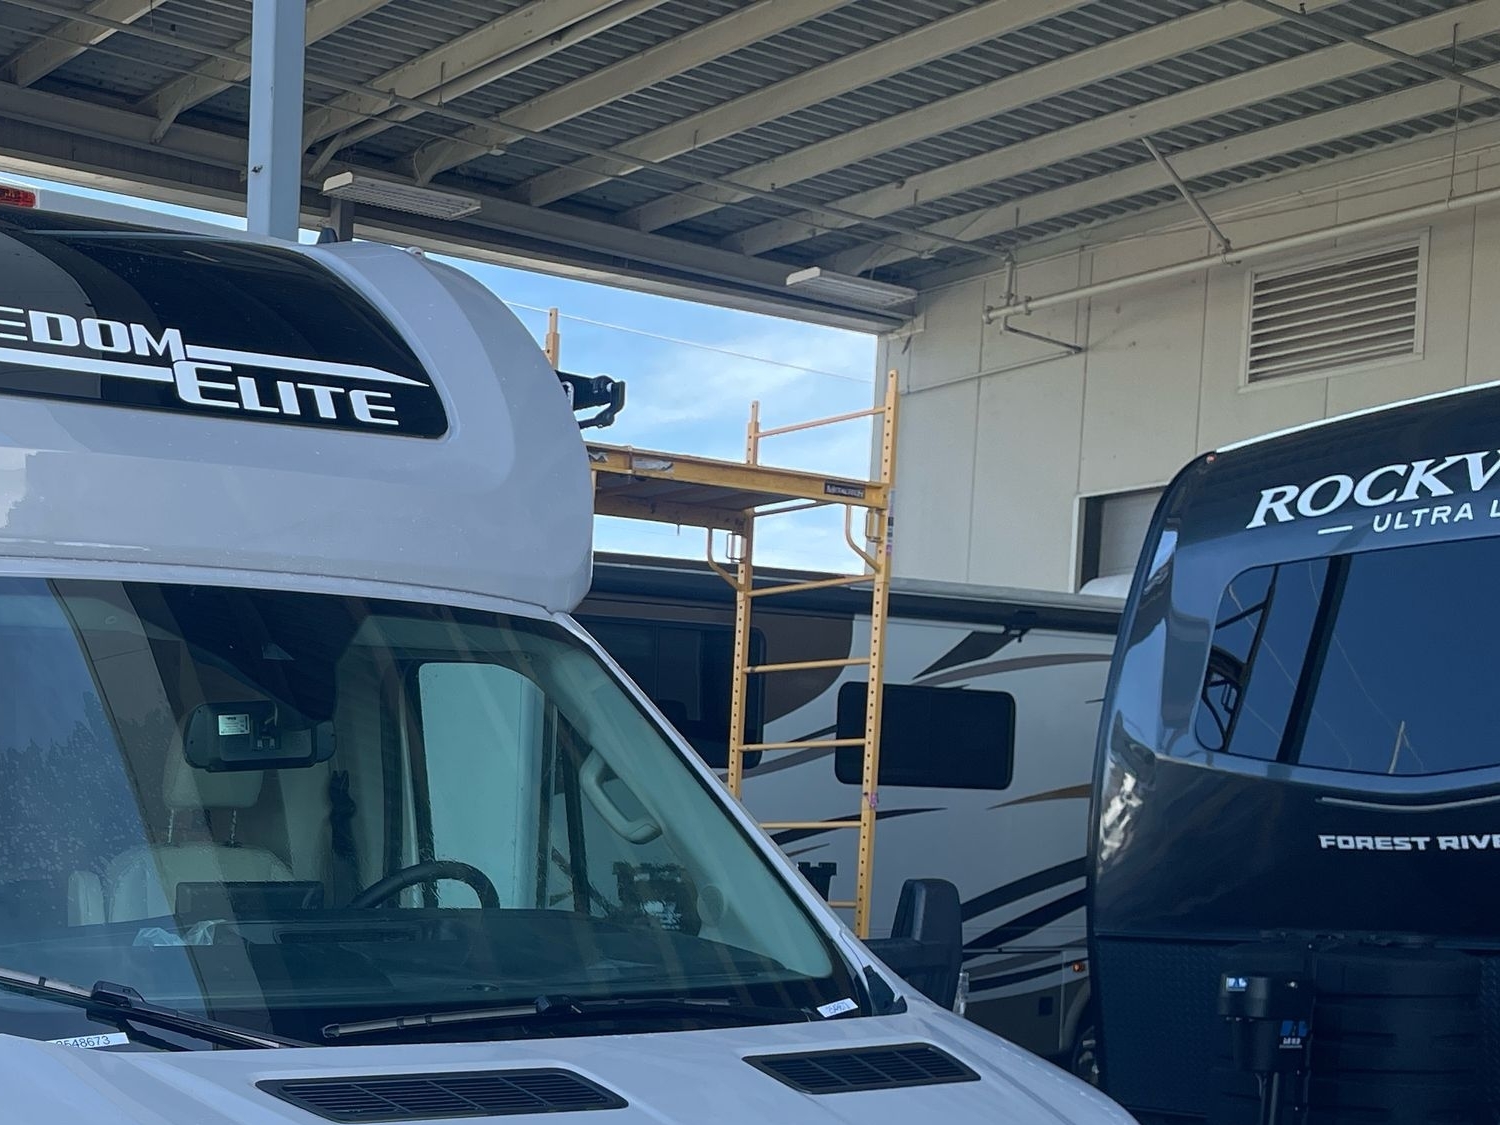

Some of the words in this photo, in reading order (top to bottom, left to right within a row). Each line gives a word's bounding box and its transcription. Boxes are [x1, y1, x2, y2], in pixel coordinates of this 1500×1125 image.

[173, 358, 399, 426] ELITE
[1372, 502, 1474, 533] ULTRA
[1318, 834, 1431, 851] FOREST
